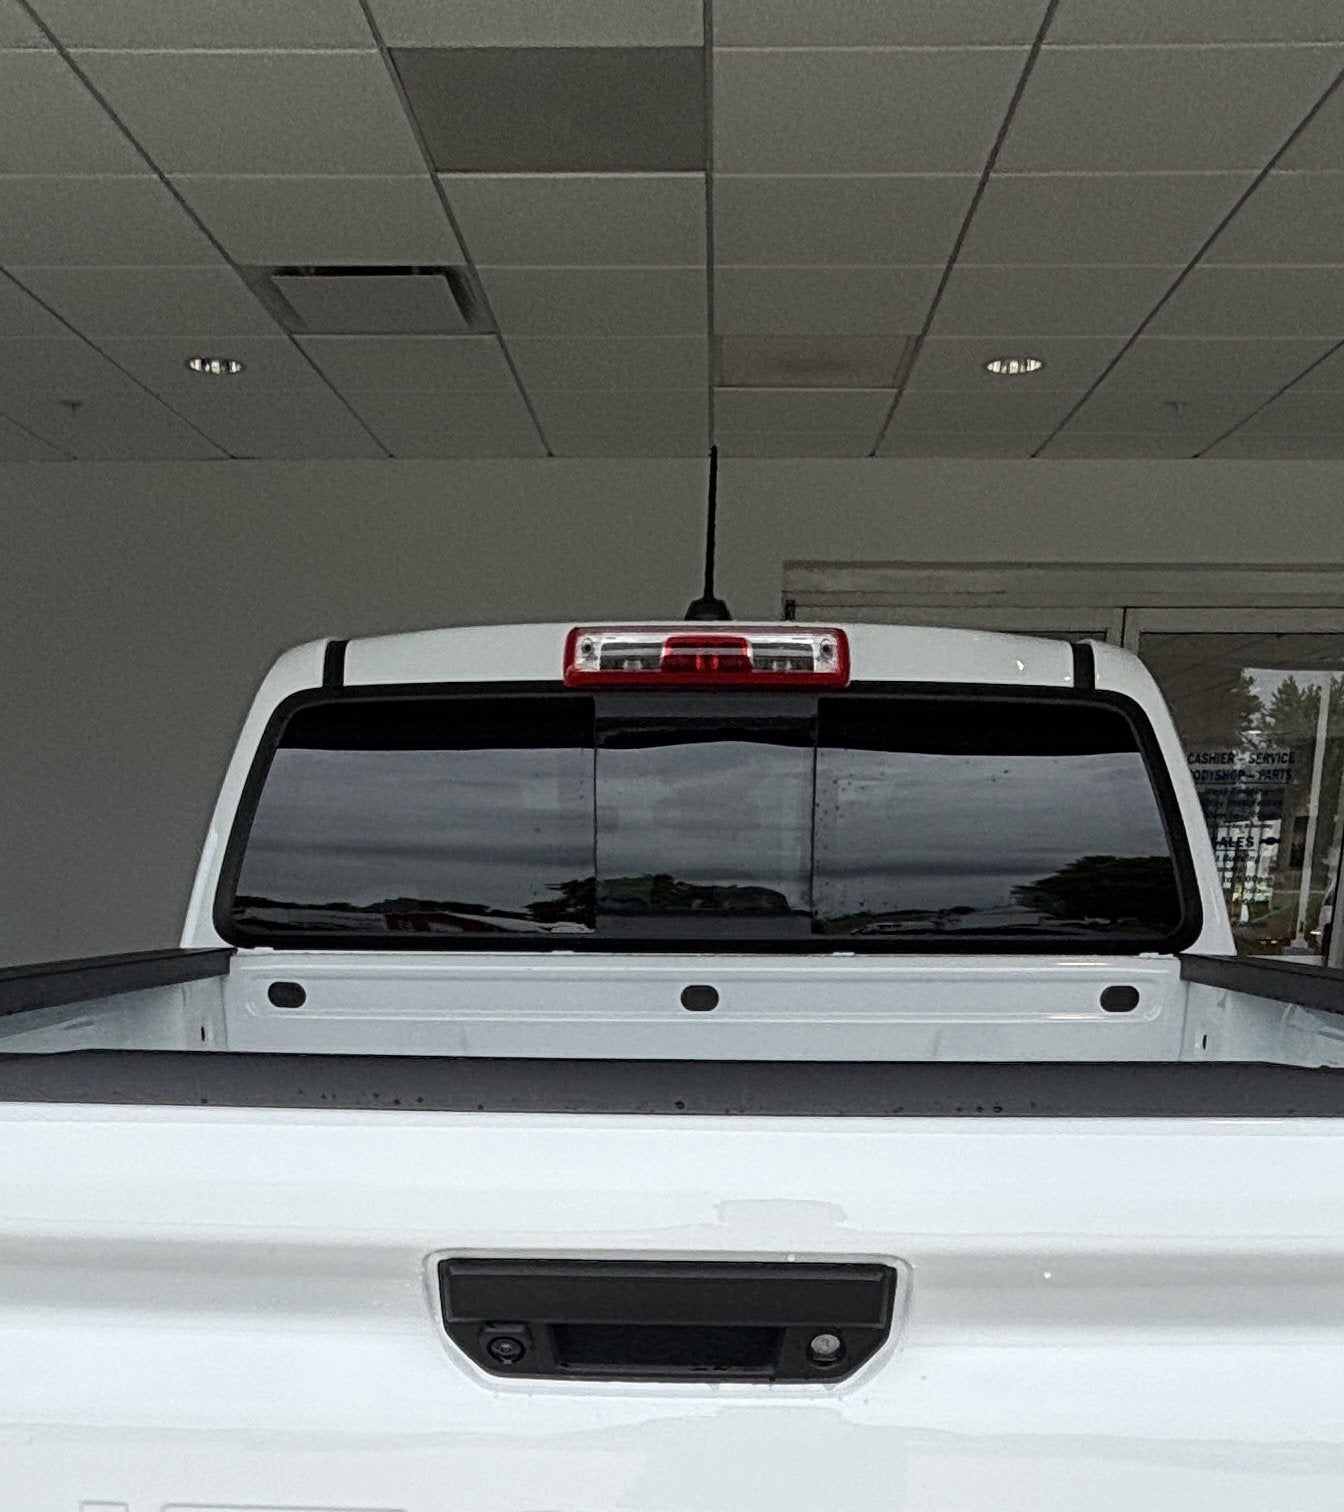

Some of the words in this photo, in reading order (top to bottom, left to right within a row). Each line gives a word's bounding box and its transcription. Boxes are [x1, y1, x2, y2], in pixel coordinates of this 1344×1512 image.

[1187, 752, 1235, 765] CASHIER
[1248, 751, 1297, 765] SERVICE
[1190, 768, 1245, 781] ODYSHOP
[1258, 768, 1293, 781] PARTS
